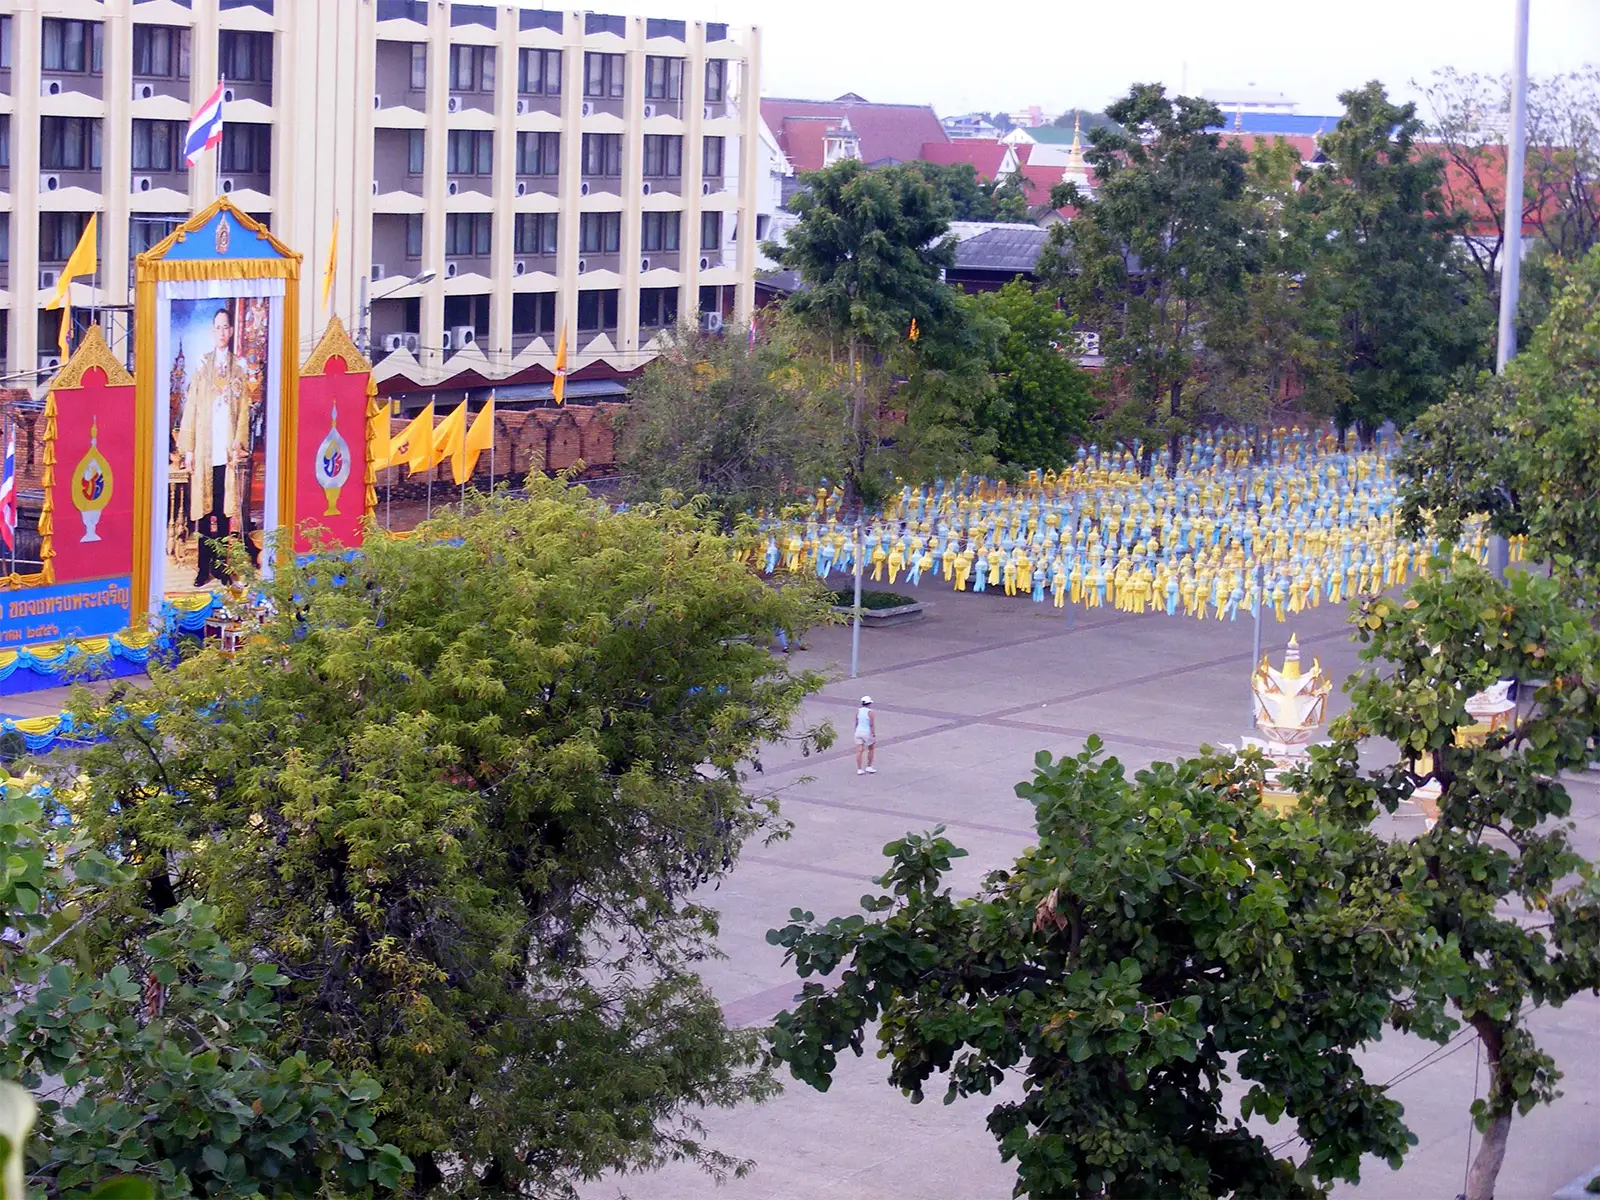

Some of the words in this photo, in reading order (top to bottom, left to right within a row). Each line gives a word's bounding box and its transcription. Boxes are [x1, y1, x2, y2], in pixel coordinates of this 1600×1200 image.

[9, 584, 129, 618] ขอจงทรงพระเจริญ
